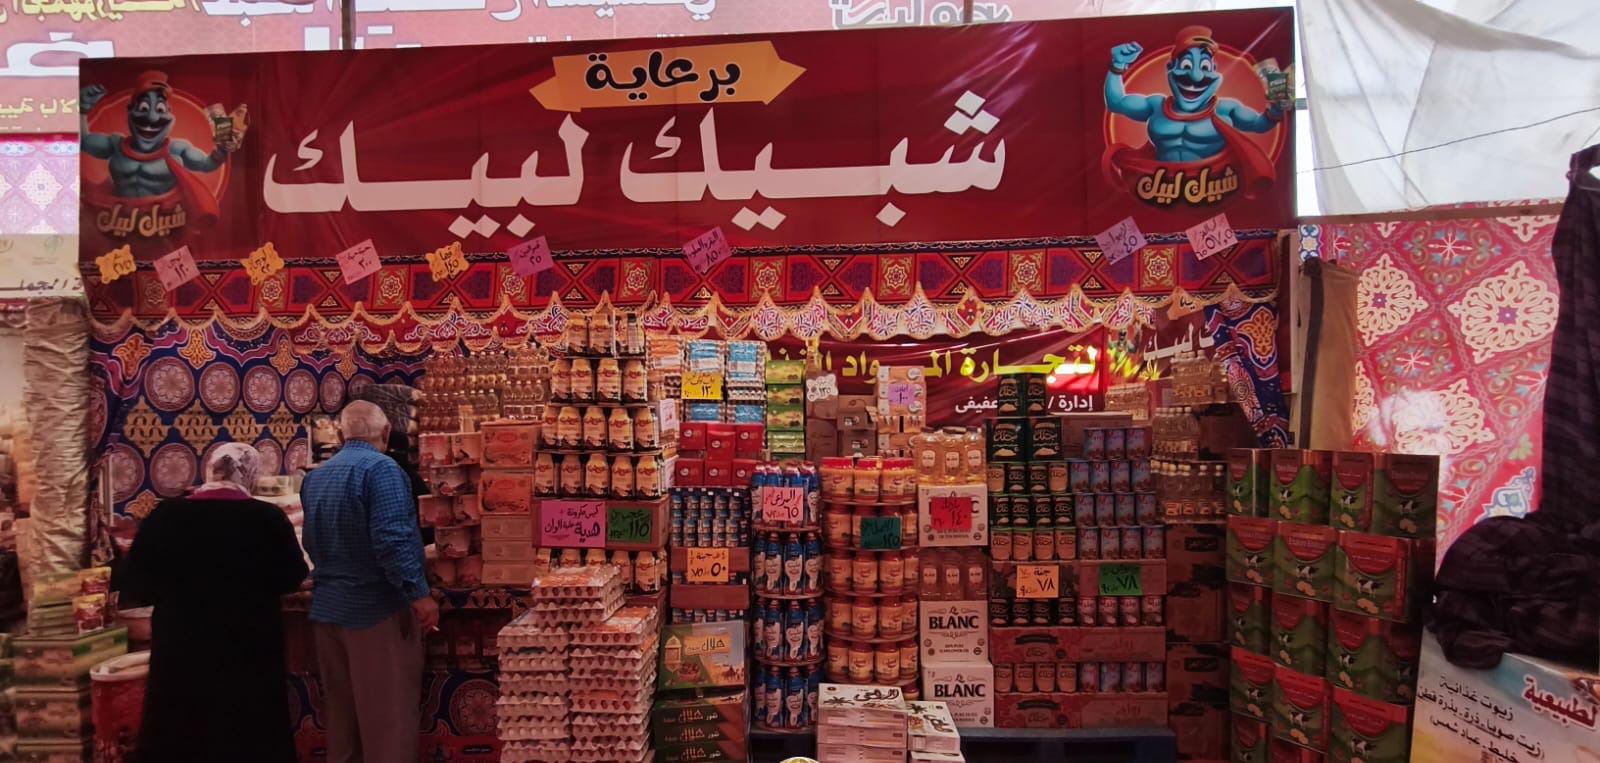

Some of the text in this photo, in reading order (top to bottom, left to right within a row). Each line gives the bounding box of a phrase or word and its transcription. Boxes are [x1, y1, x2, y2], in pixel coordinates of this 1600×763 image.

[584, 50, 741, 102] برعاية
[262, 90, 1006, 240] شبيك لبيك
[1137, 167, 1238, 204] شبيك لبيك
[97, 203, 187, 238] شبيك لبيك
[960, 343, 1097, 384] لتجارة
[1058, 394, 1093, 412] إدارة
[784, 505, 800, 519] ٦٥
[575, 521, 601, 543] هدية
[1037, 577, 1055, 592] ٧٨
[1117, 575, 1138, 591] ٧٨
[928, 615, 979, 630] BLANC
[702, 637, 725, 651] هلال
[934, 684, 986, 698] BLANC
[1440, 676, 1513, 721] زيوت غذائية
[1460, 729, 1481, 748] عباد
